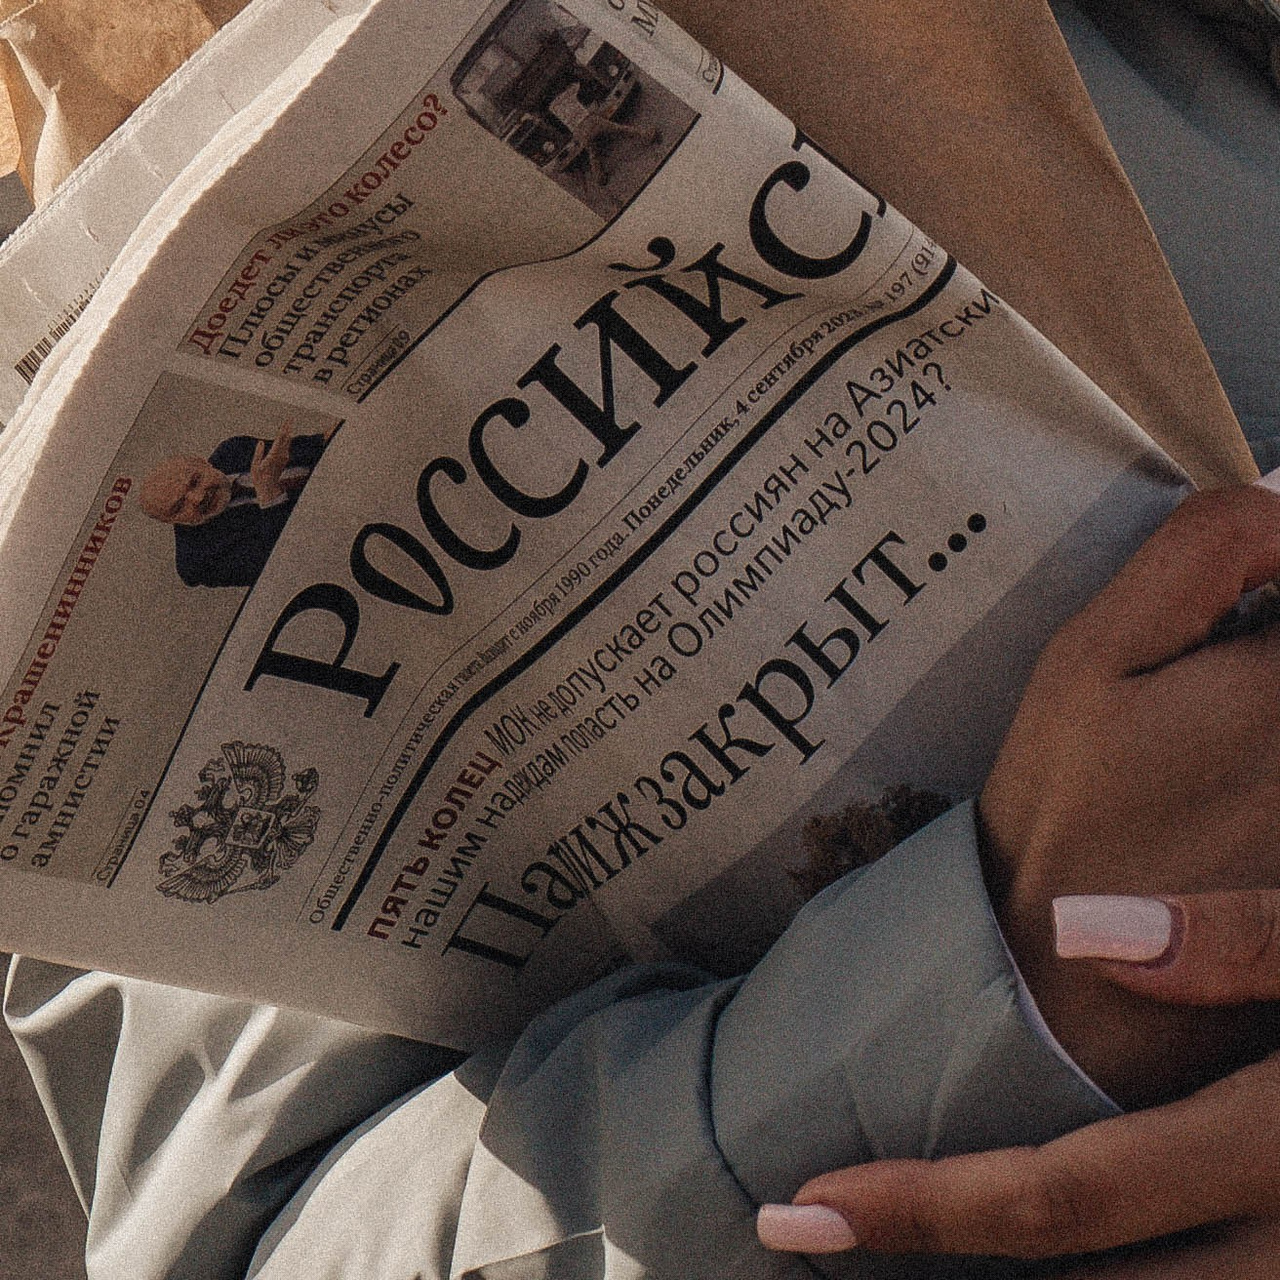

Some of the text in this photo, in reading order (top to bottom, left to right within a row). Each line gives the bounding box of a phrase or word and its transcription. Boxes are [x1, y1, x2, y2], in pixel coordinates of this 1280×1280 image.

[191, 247, 272, 353] Доедет
[345, 91, 449, 206] колесо?
[217, 262, 301, 359] Плюсы
[294, 244, 320, 262] и
[312, 264, 431, 384] в регионах
[309, 679, 460, 923] Общественно-политическая
[515, 589, 561, 634] ноября
[554, 560, 591, 597] 1990
[587, 529, 629, 569] года.
[623, 415, 739, 531] Понедельник,
[733, 399, 750, 416] 4
[746, 328, 824, 404] сентября
[884, 271, 913, 302] 197
[366, 854, 430, 940] ПЯТЬ
[417, 748, 504, 848] КОЛЕЦ
[483, 703, 541, 758] МОК
[530, 697, 560, 725] не
[546, 591, 675, 717] допускает
[668, 450, 808, 605] россиян
[803, 408, 851, 459] на
[401, 358, 955, 949] нашим надеждам попасть на Олимпиаду-2024?
[633, 513, 987, 831] закрыт...
[0, 690, 101, 861] о гаражной
[31, 716, 120, 868] амнистии
